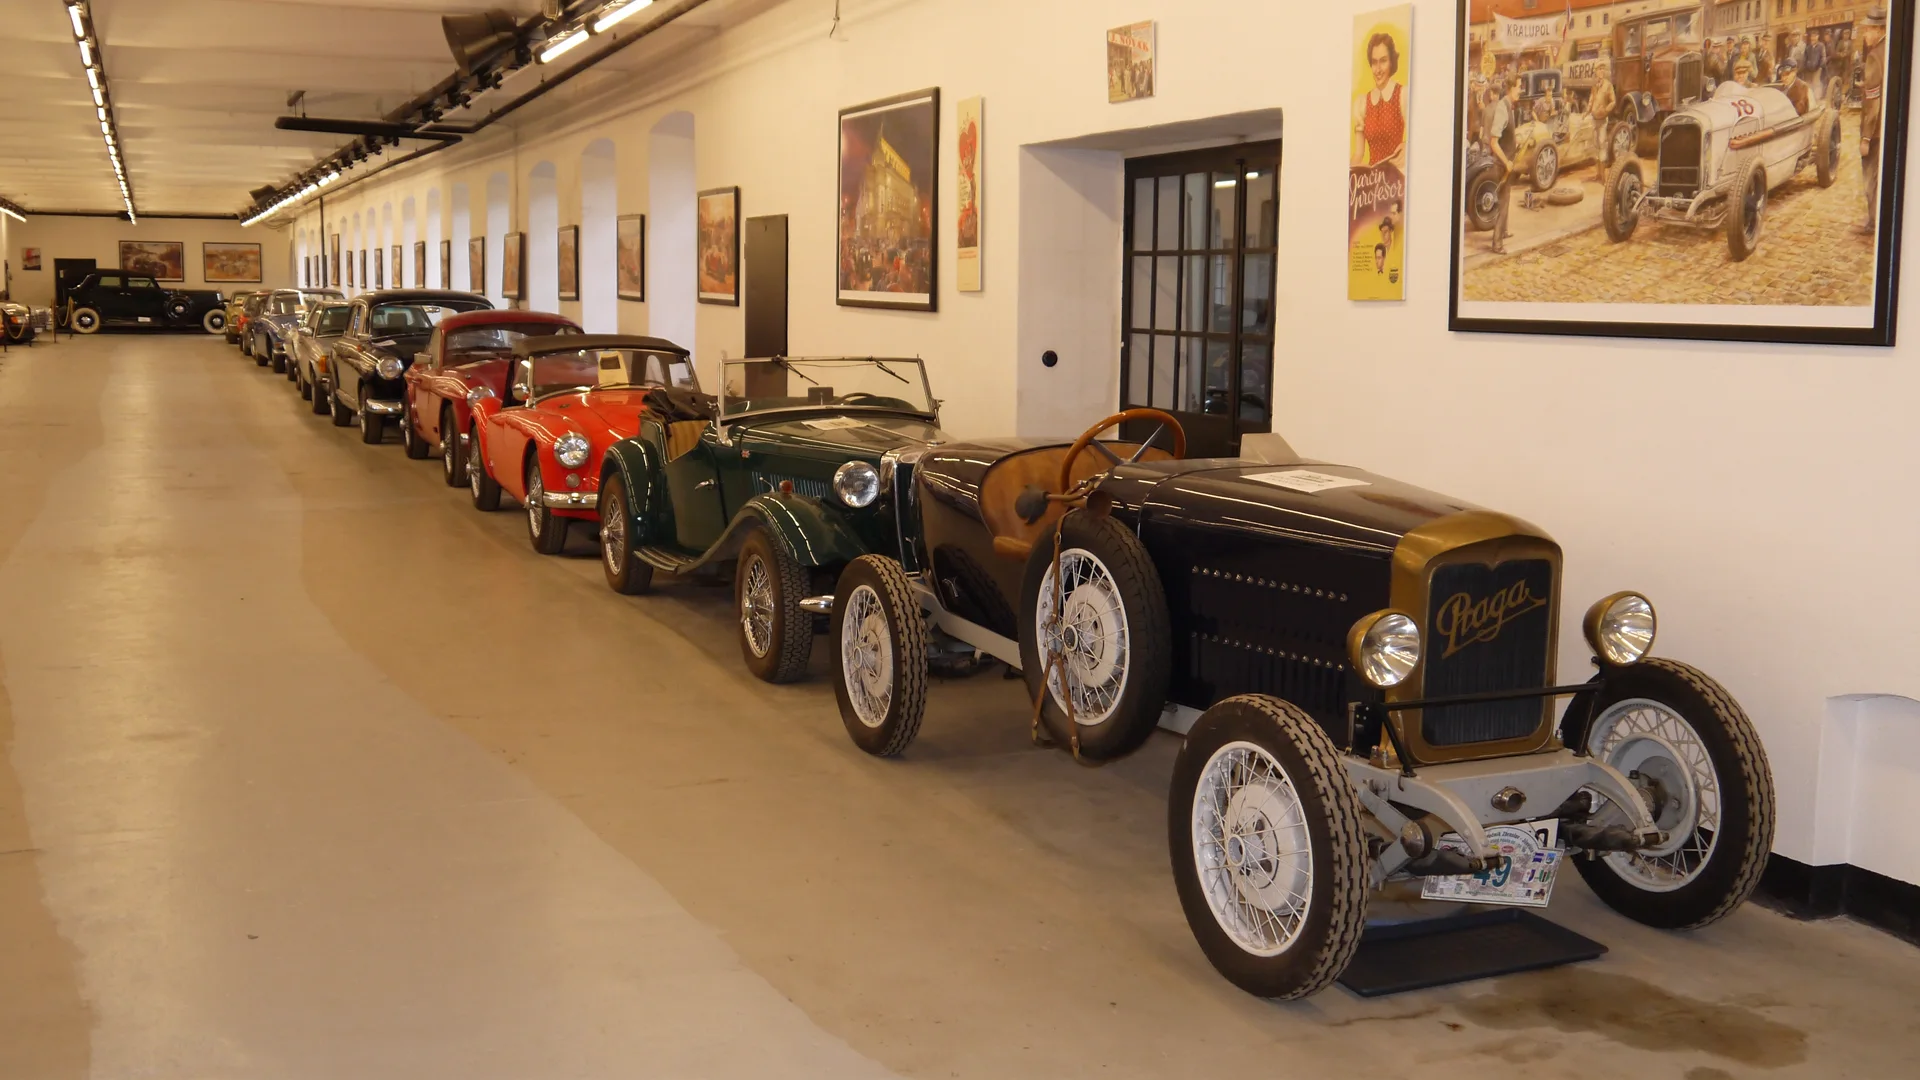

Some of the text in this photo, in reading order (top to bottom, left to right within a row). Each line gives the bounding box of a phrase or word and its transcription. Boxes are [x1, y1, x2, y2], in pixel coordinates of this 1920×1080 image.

[1506, 22, 1550, 38] KRALUPOL
[1731, 99, 1754, 117] 18
[1353, 180, 1405, 220] profesor
[1436, 579, 1547, 660] Praga
